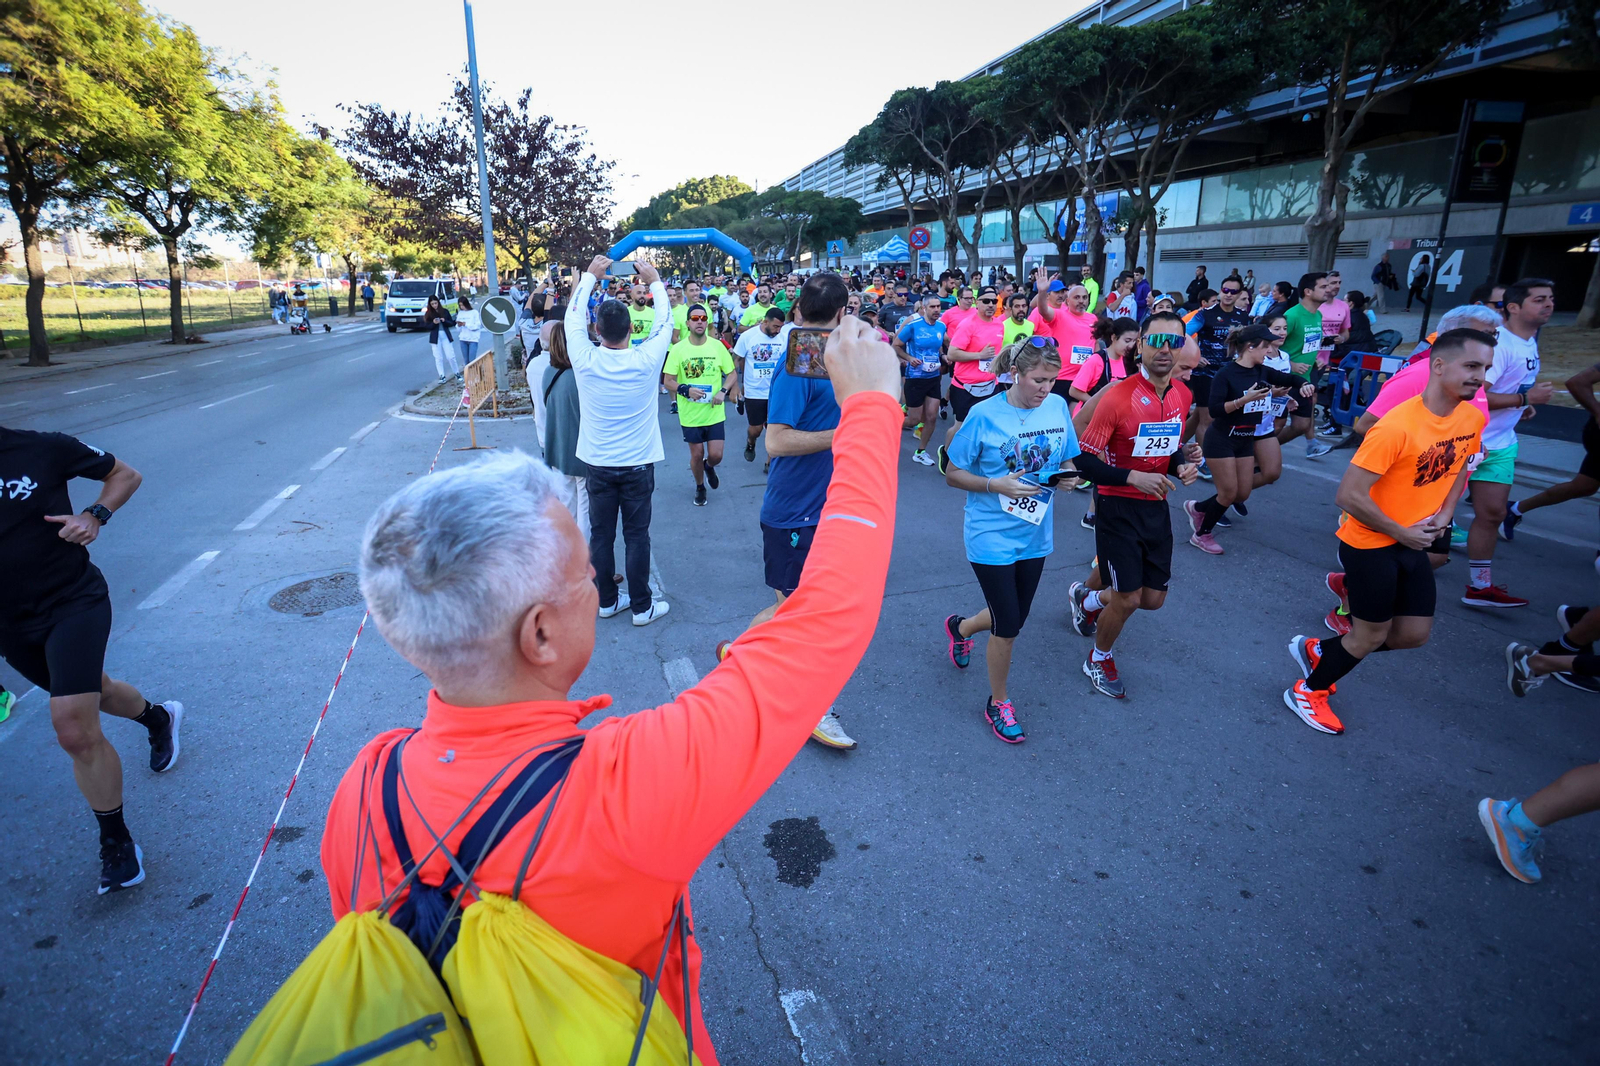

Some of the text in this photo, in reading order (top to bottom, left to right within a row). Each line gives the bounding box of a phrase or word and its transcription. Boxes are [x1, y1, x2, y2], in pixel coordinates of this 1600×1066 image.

[1579, 207, 1593, 222] 4
[1407, 249, 1465, 293] 04
[1251, 398, 1266, 408] 312
[1018, 427, 1064, 439] CARRERA POPULAR
[1145, 437, 1170, 449] 243
